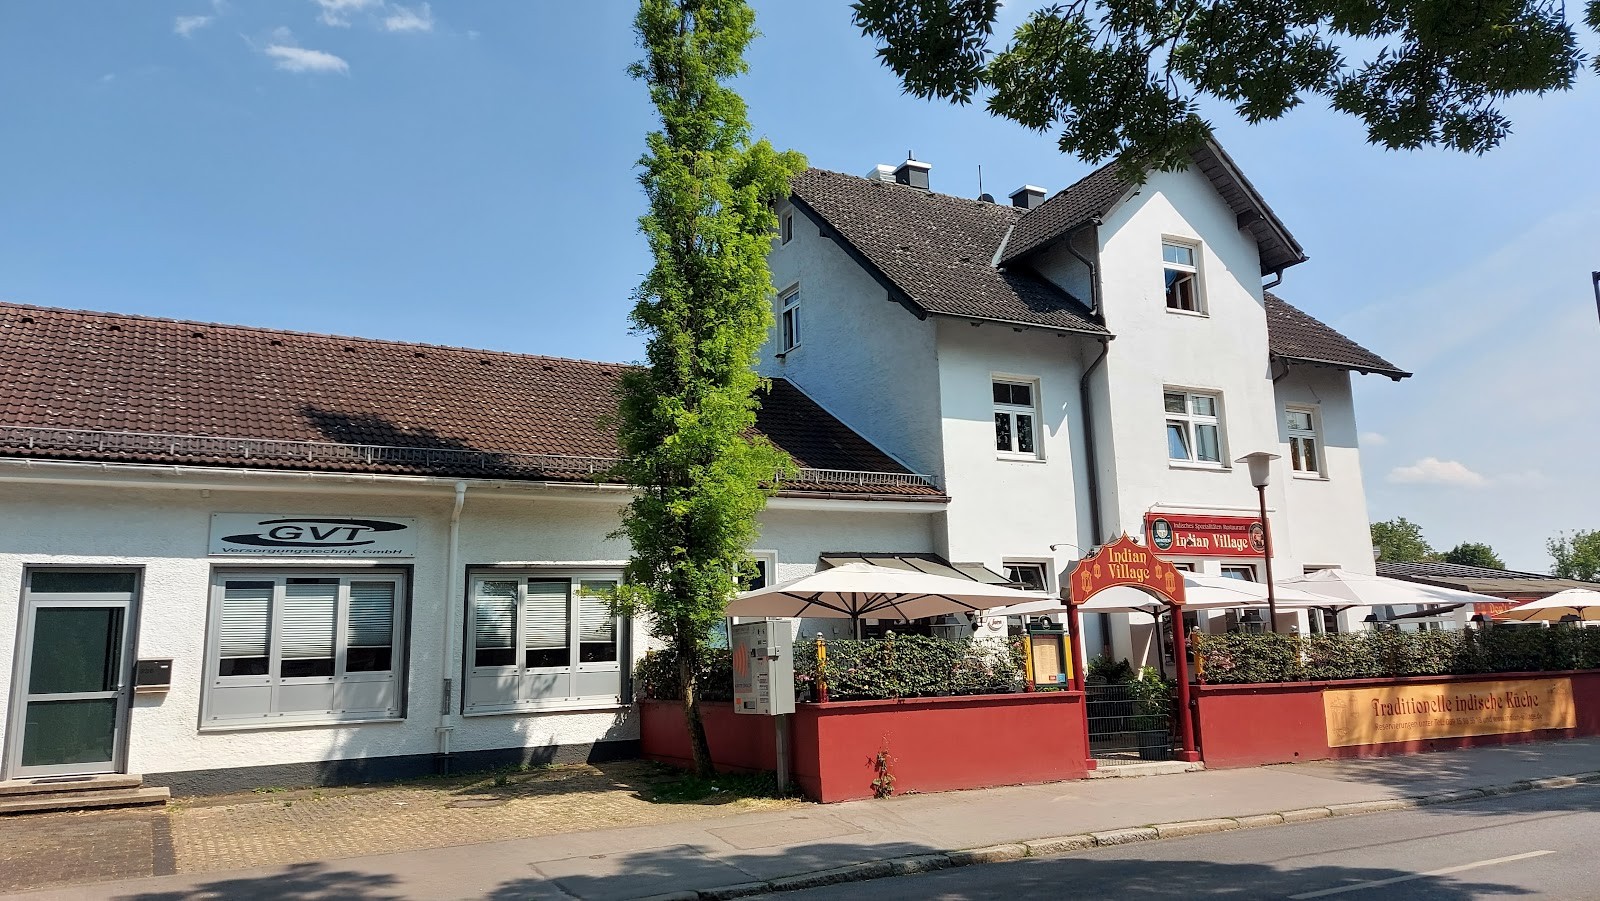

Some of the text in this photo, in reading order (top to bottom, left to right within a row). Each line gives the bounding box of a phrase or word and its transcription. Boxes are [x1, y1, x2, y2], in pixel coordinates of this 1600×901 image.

[268, 525, 371, 542] GVT
[1212, 533, 1249, 552] Village
[222, 547, 358, 555] Versorgungstechnik
[1107, 547, 1150, 583] Indian Village
[1371, 690, 1539, 717] Traditionelle indische Küche
[1375, 720, 1418, 731] Reservierungen
[1418, 719, 1434, 728] unter
